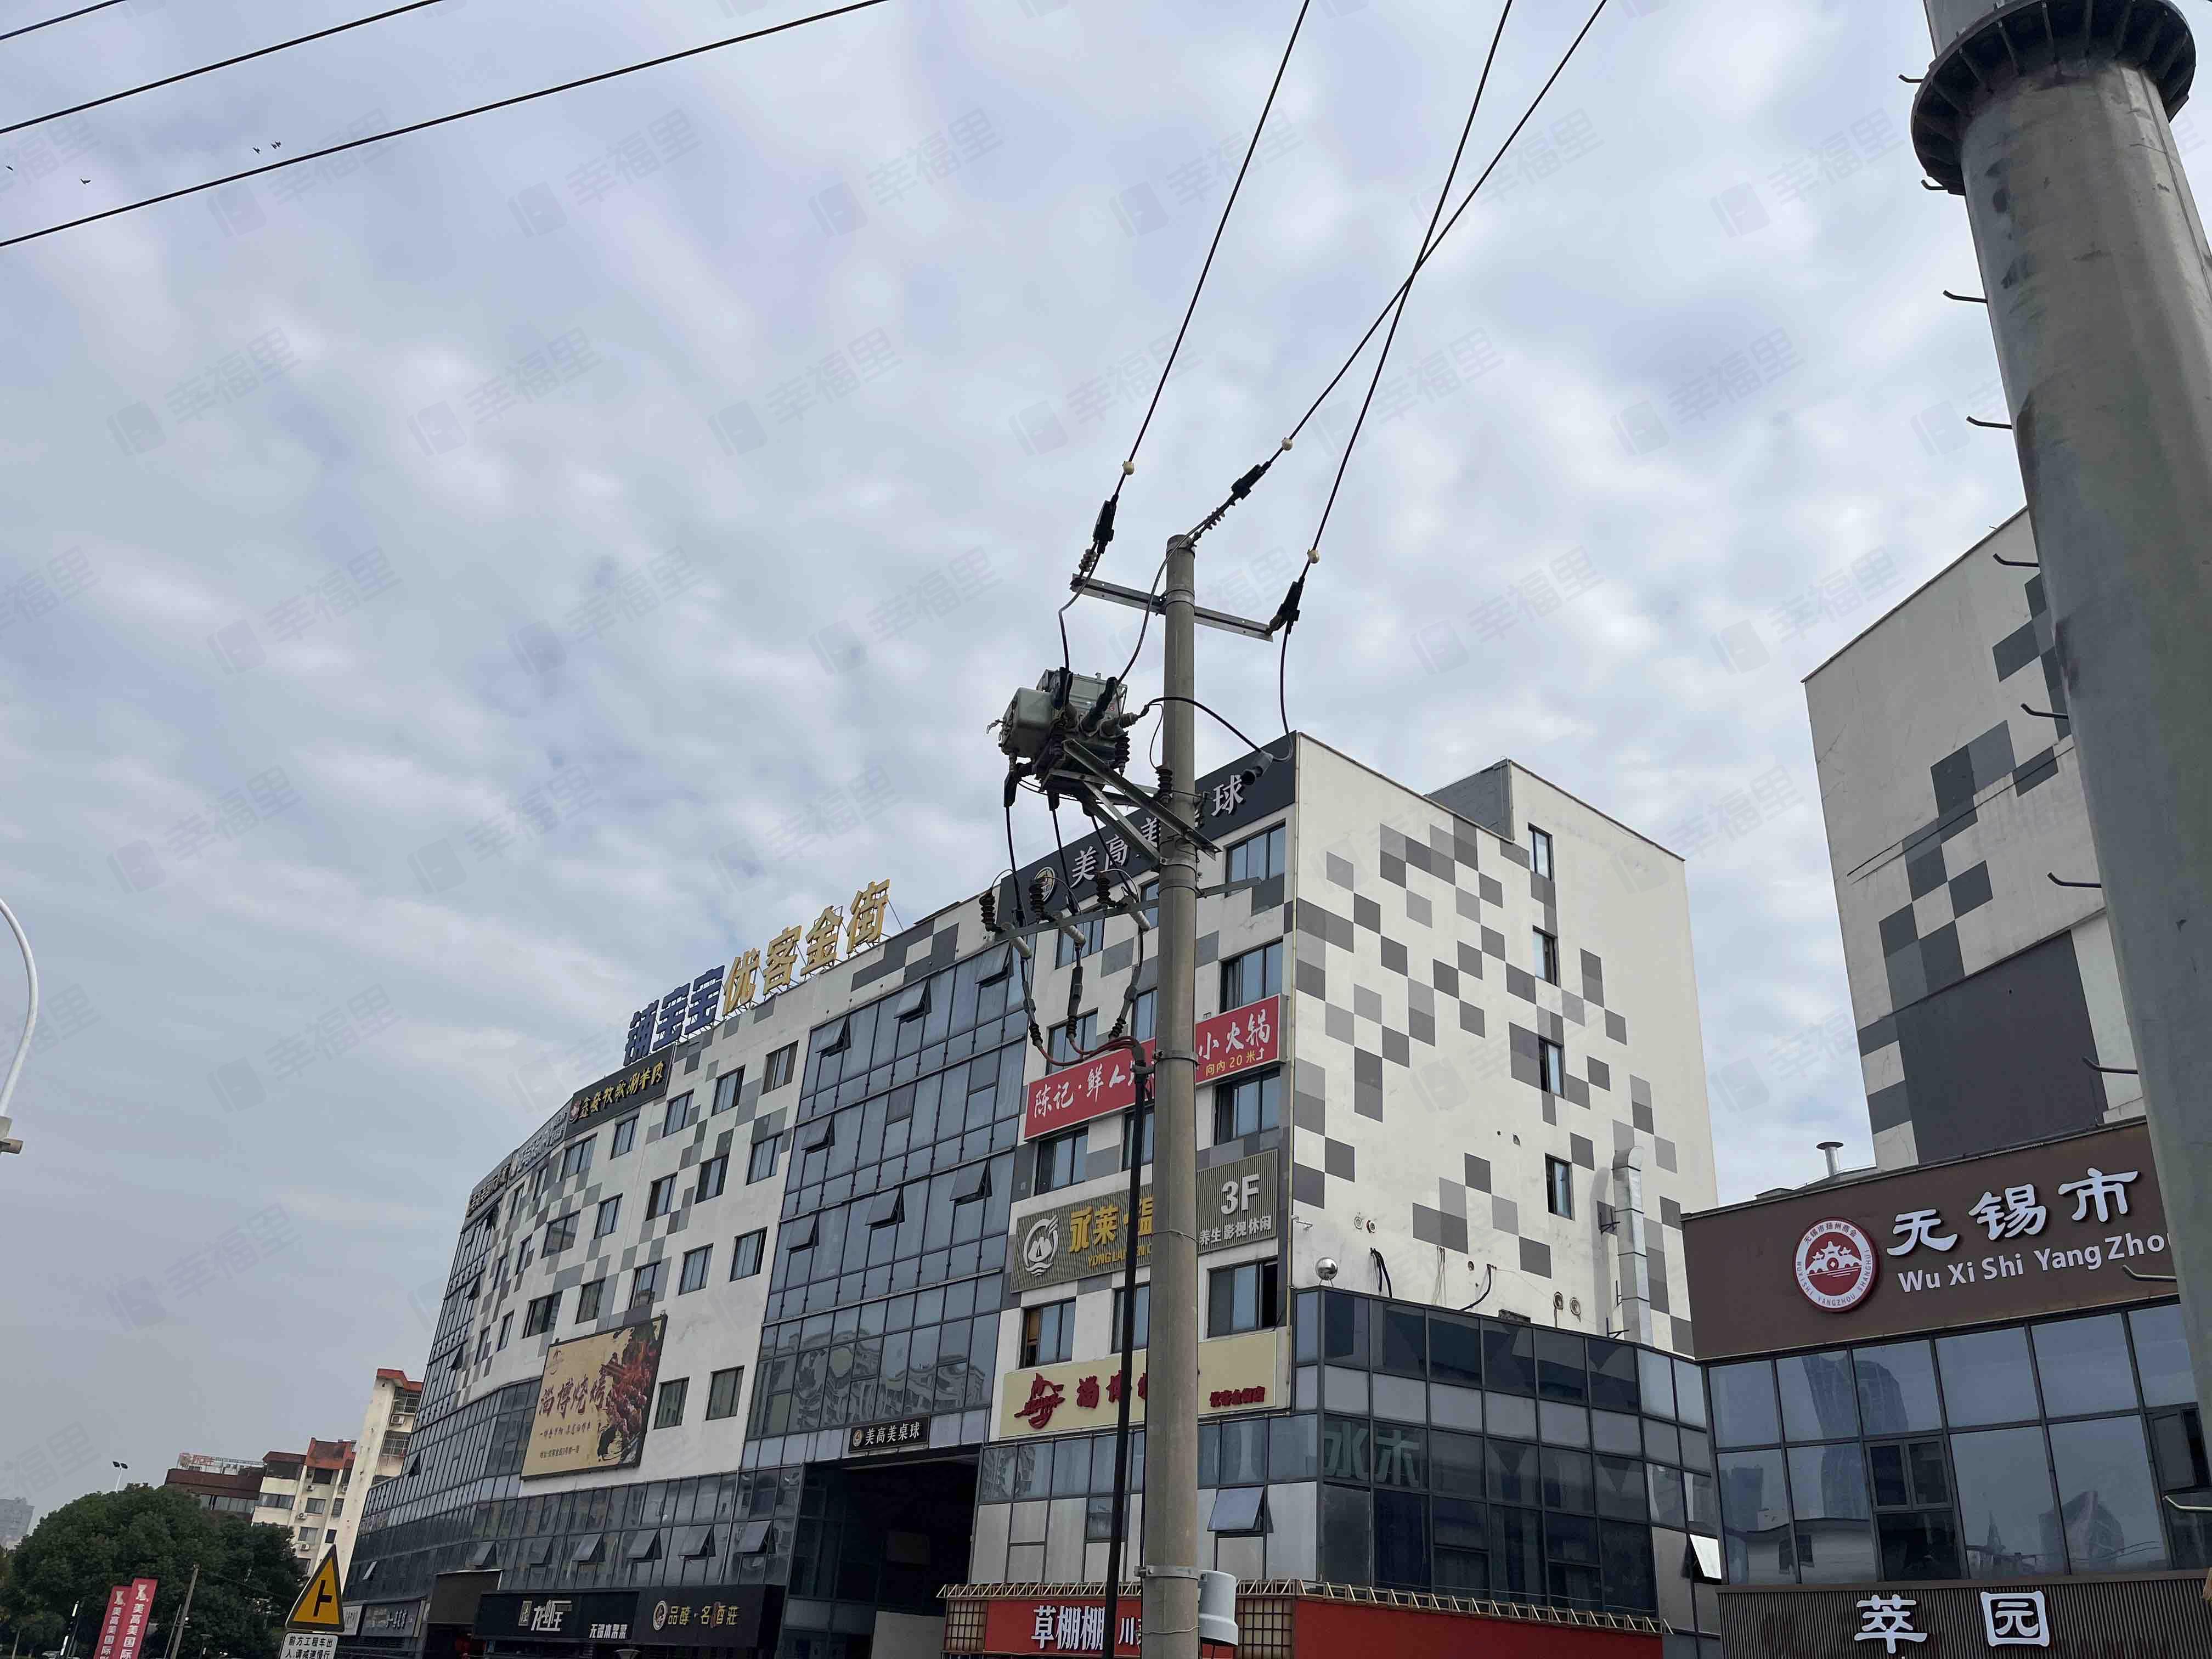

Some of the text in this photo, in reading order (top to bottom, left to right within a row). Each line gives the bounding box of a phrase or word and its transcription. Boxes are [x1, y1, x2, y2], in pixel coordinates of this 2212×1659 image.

[1070, 775, 1244, 888] 美高美球
[723, 879, 890, 1016] 优客金街
[1221, 1174, 1260, 1215] 3F
[1886, 1167, 2138, 1257] 无锡市
[1804, 1222, 1858, 1244] 无锡市扬州商会
[1817, 1294, 1856, 1306] YANGZHOU
[1857, 1249, 1872, 1292] SHANGHUI
[1897, 1232, 2172, 1293] Wu Xi Shi Yang Zho
[865, 1421, 920, 1446] 美高美桌球
[99, 1607, 122, 1659] 美高美国际
[289, 1635, 333, 1647] 前方工程车出
[1031, 1605, 1105, 1650] 草棚棚
[1854, 1590, 2050, 1654] 萃园
